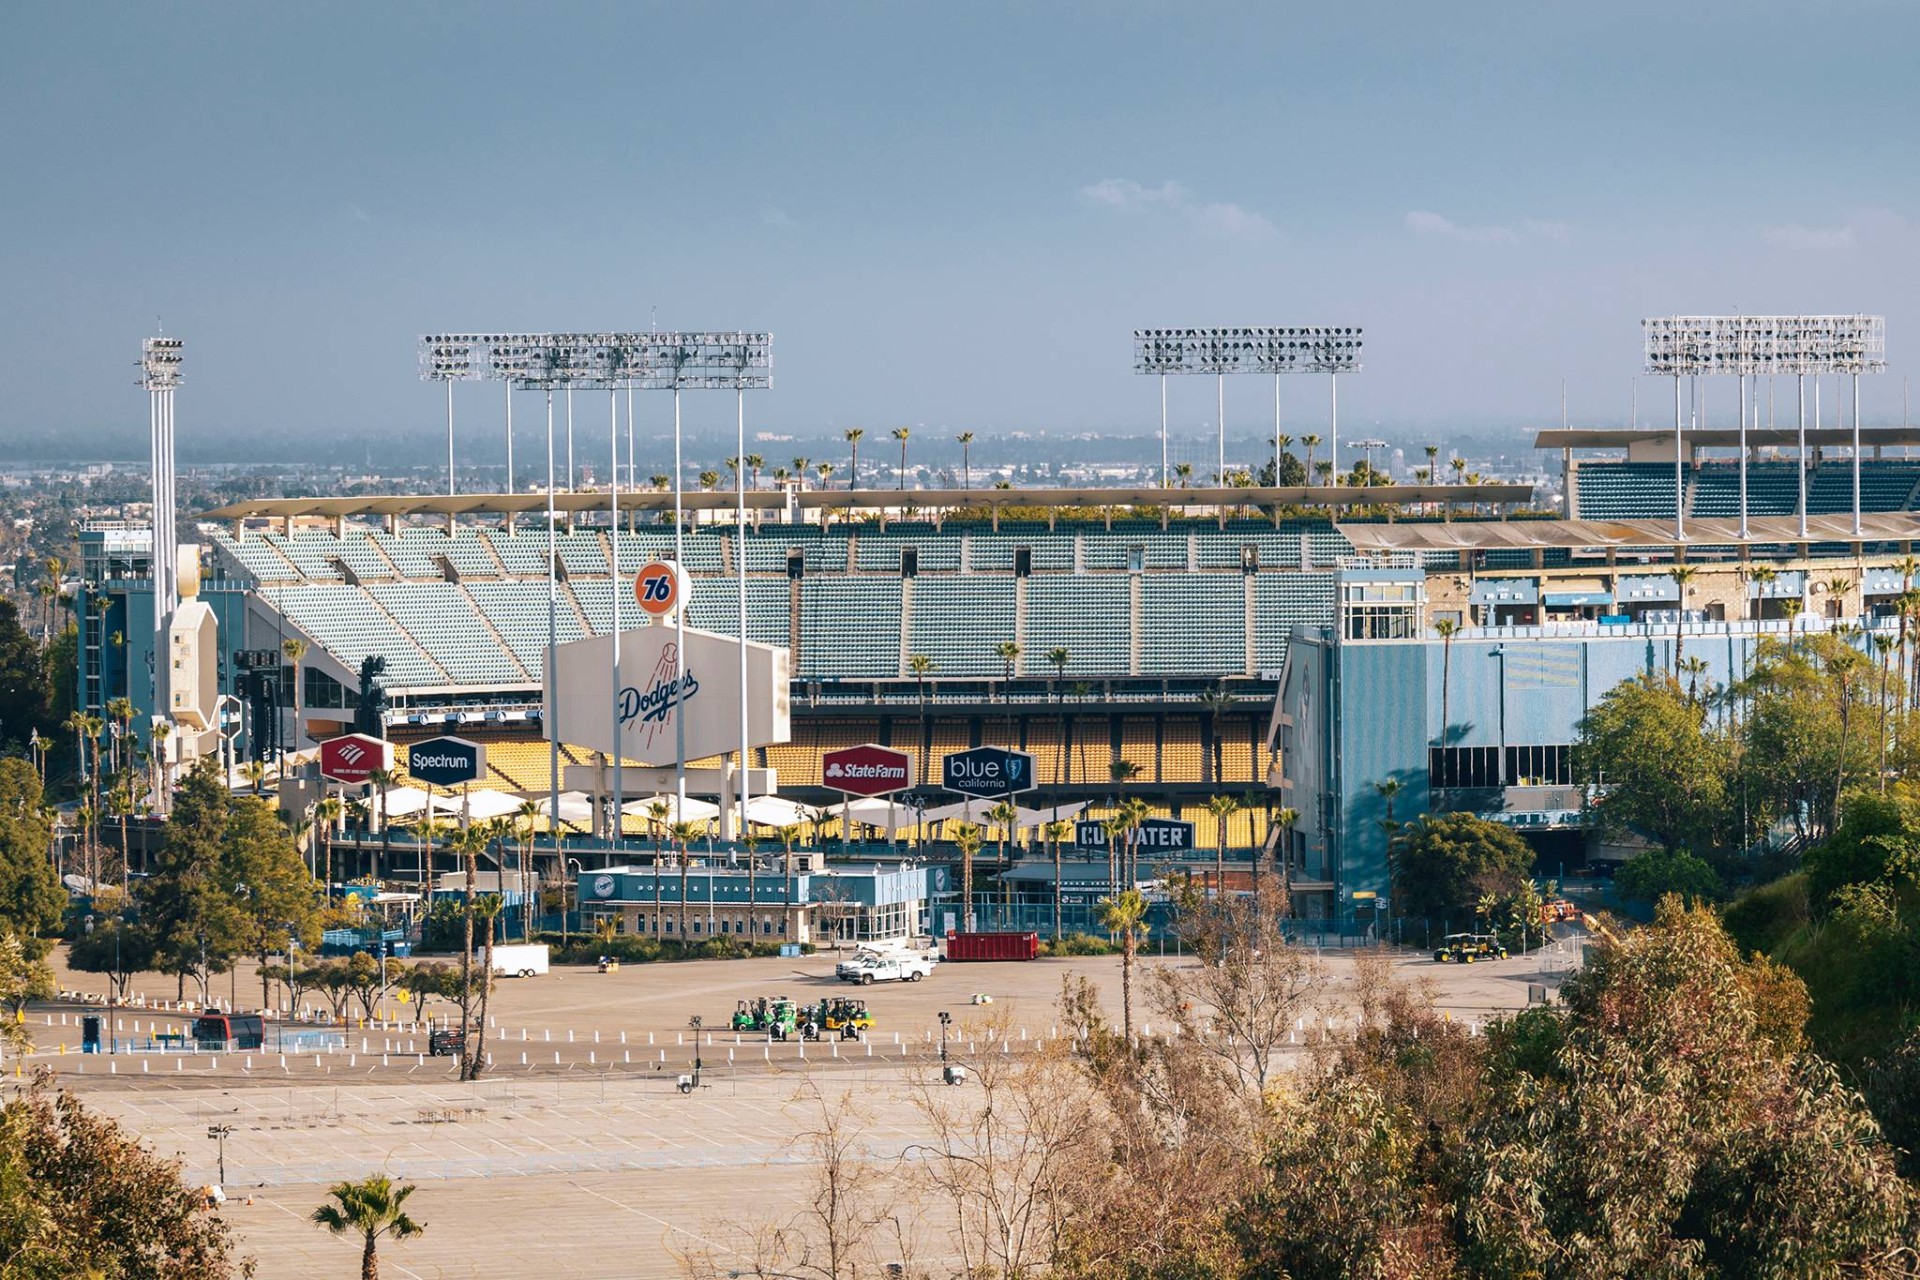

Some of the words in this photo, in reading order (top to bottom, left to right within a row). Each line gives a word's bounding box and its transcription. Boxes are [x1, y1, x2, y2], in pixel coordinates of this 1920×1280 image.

[643, 575, 670, 601] 76
[620, 669, 698, 724] Dodges
[412, 753, 468, 770] Spectrum
[951, 757, 999, 777] blue
[958, 779, 1005, 788] california
[1081, 827, 1183, 846] CUATER
